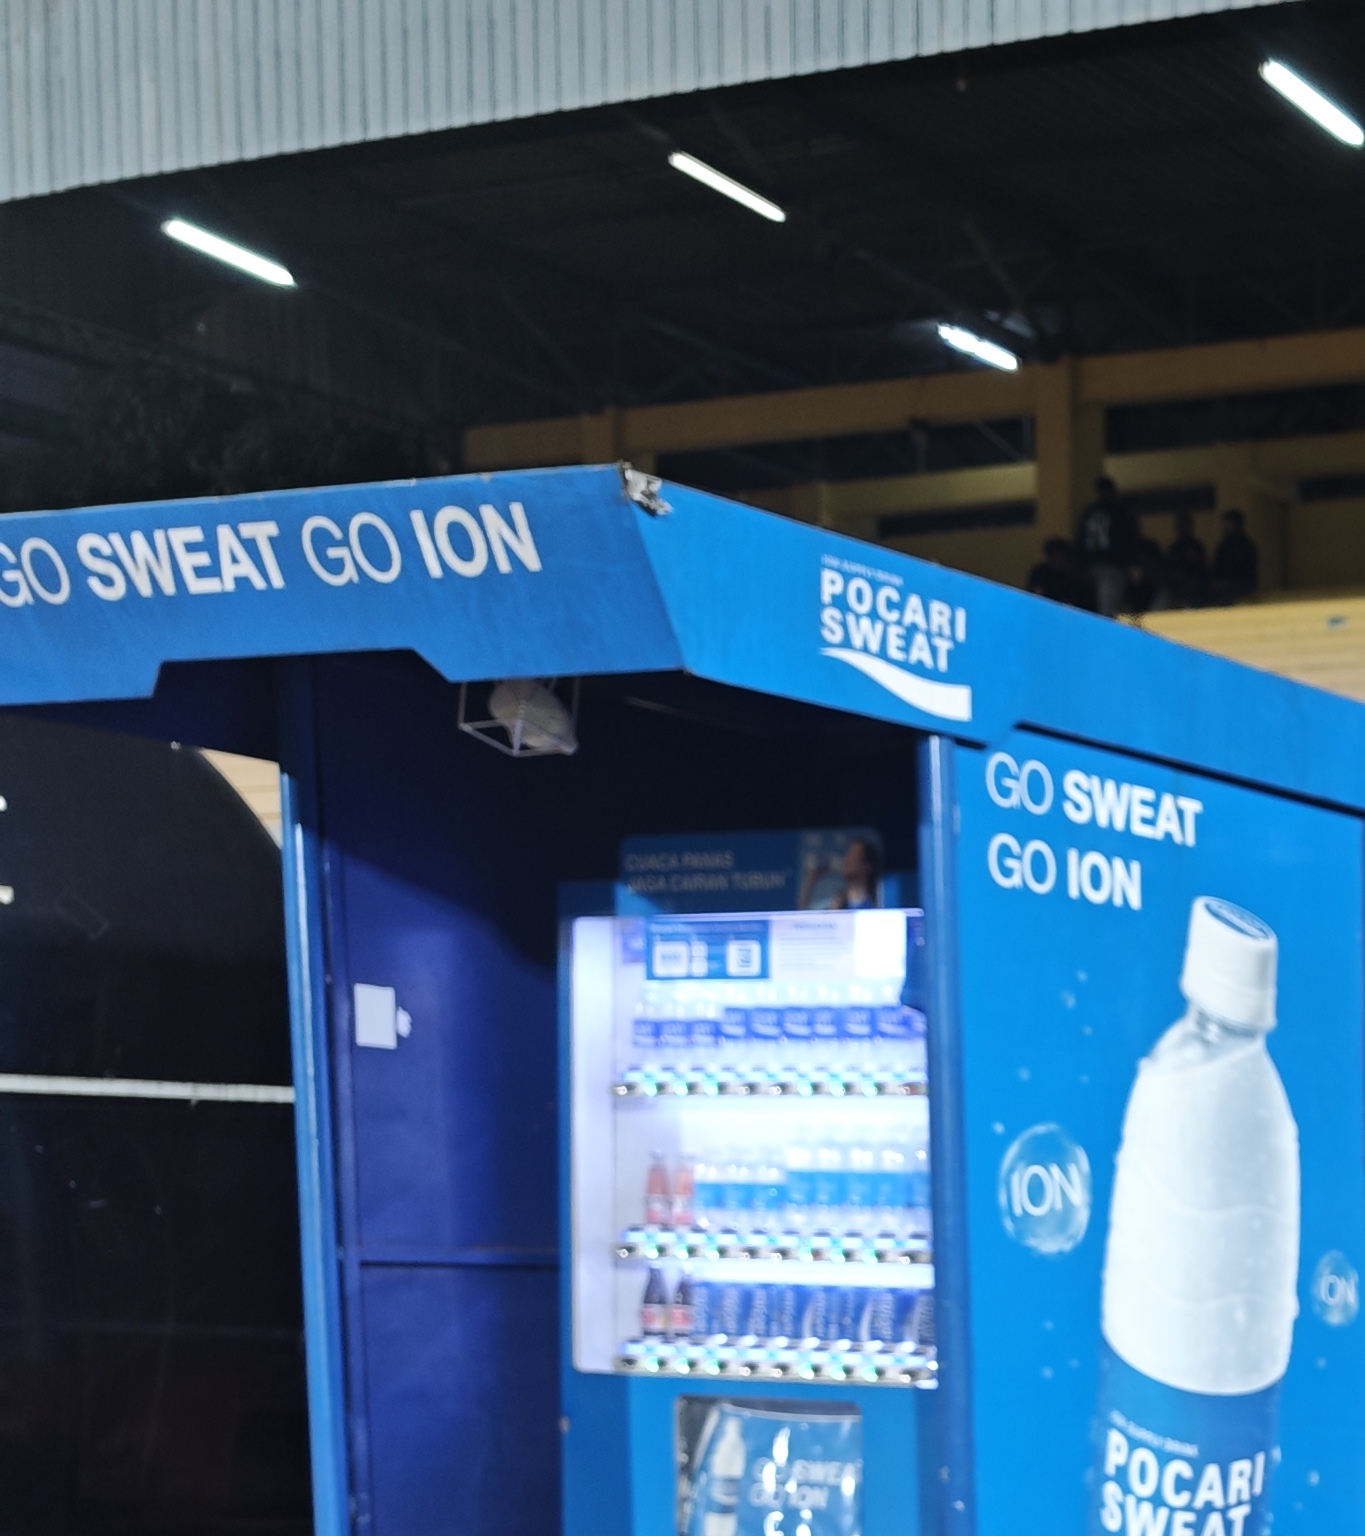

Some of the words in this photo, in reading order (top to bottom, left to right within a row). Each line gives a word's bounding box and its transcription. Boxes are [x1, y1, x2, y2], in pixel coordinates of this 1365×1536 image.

[76, 520, 286, 603] SWEAT
[301, 511, 403, 587] GO
[409, 501, 542, 579] ION
[820, 567, 967, 643] POCARI
[820, 606, 954, 673] SWEAT
[985, 751, 1055, 816] GO
[1062, 770, 1203, 848] SWEAT
[987, 832, 1057, 895] GO
[1066, 847, 1143, 912] ION
[1009, 1163, 1083, 1217] ION
[1103, 1426, 1267, 1510] POCARI
